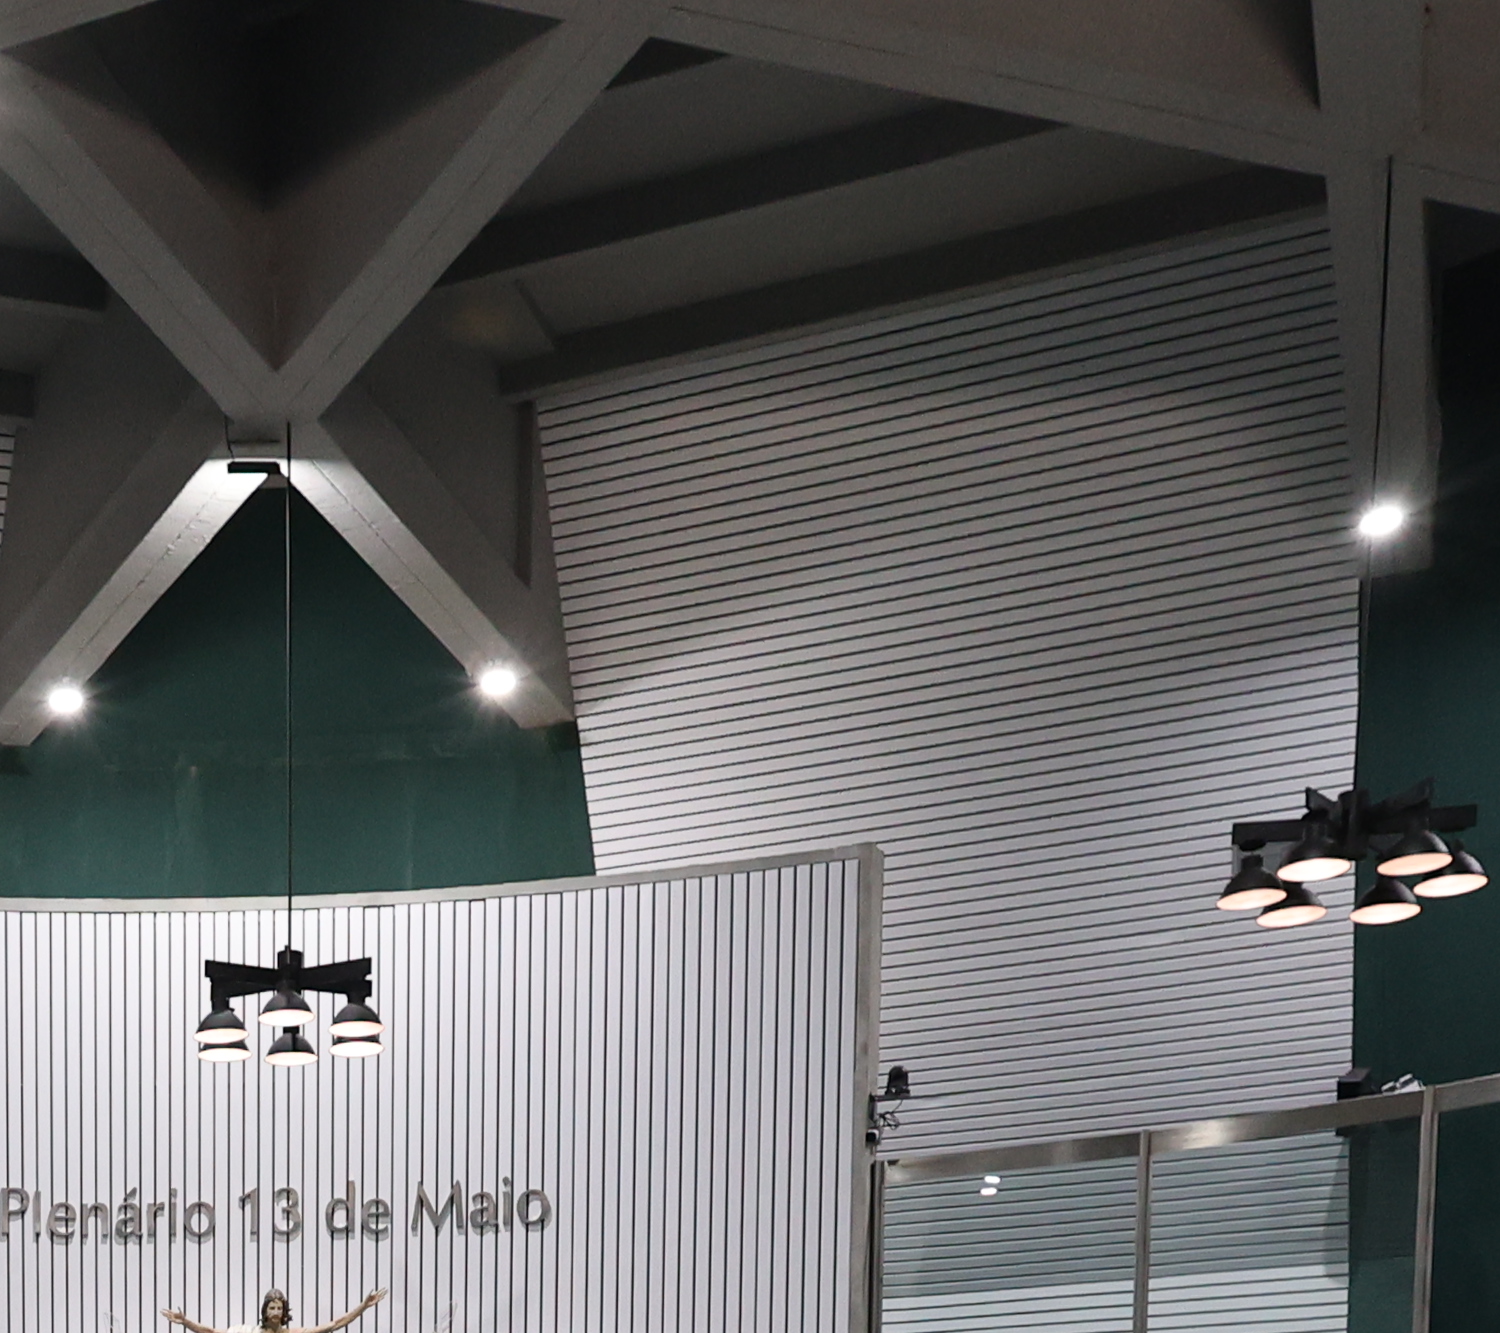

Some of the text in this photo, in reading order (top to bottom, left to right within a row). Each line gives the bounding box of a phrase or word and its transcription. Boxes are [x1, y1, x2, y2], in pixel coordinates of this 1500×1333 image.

[0, 1176, 552, 1241] Plenário 13 de Maio
